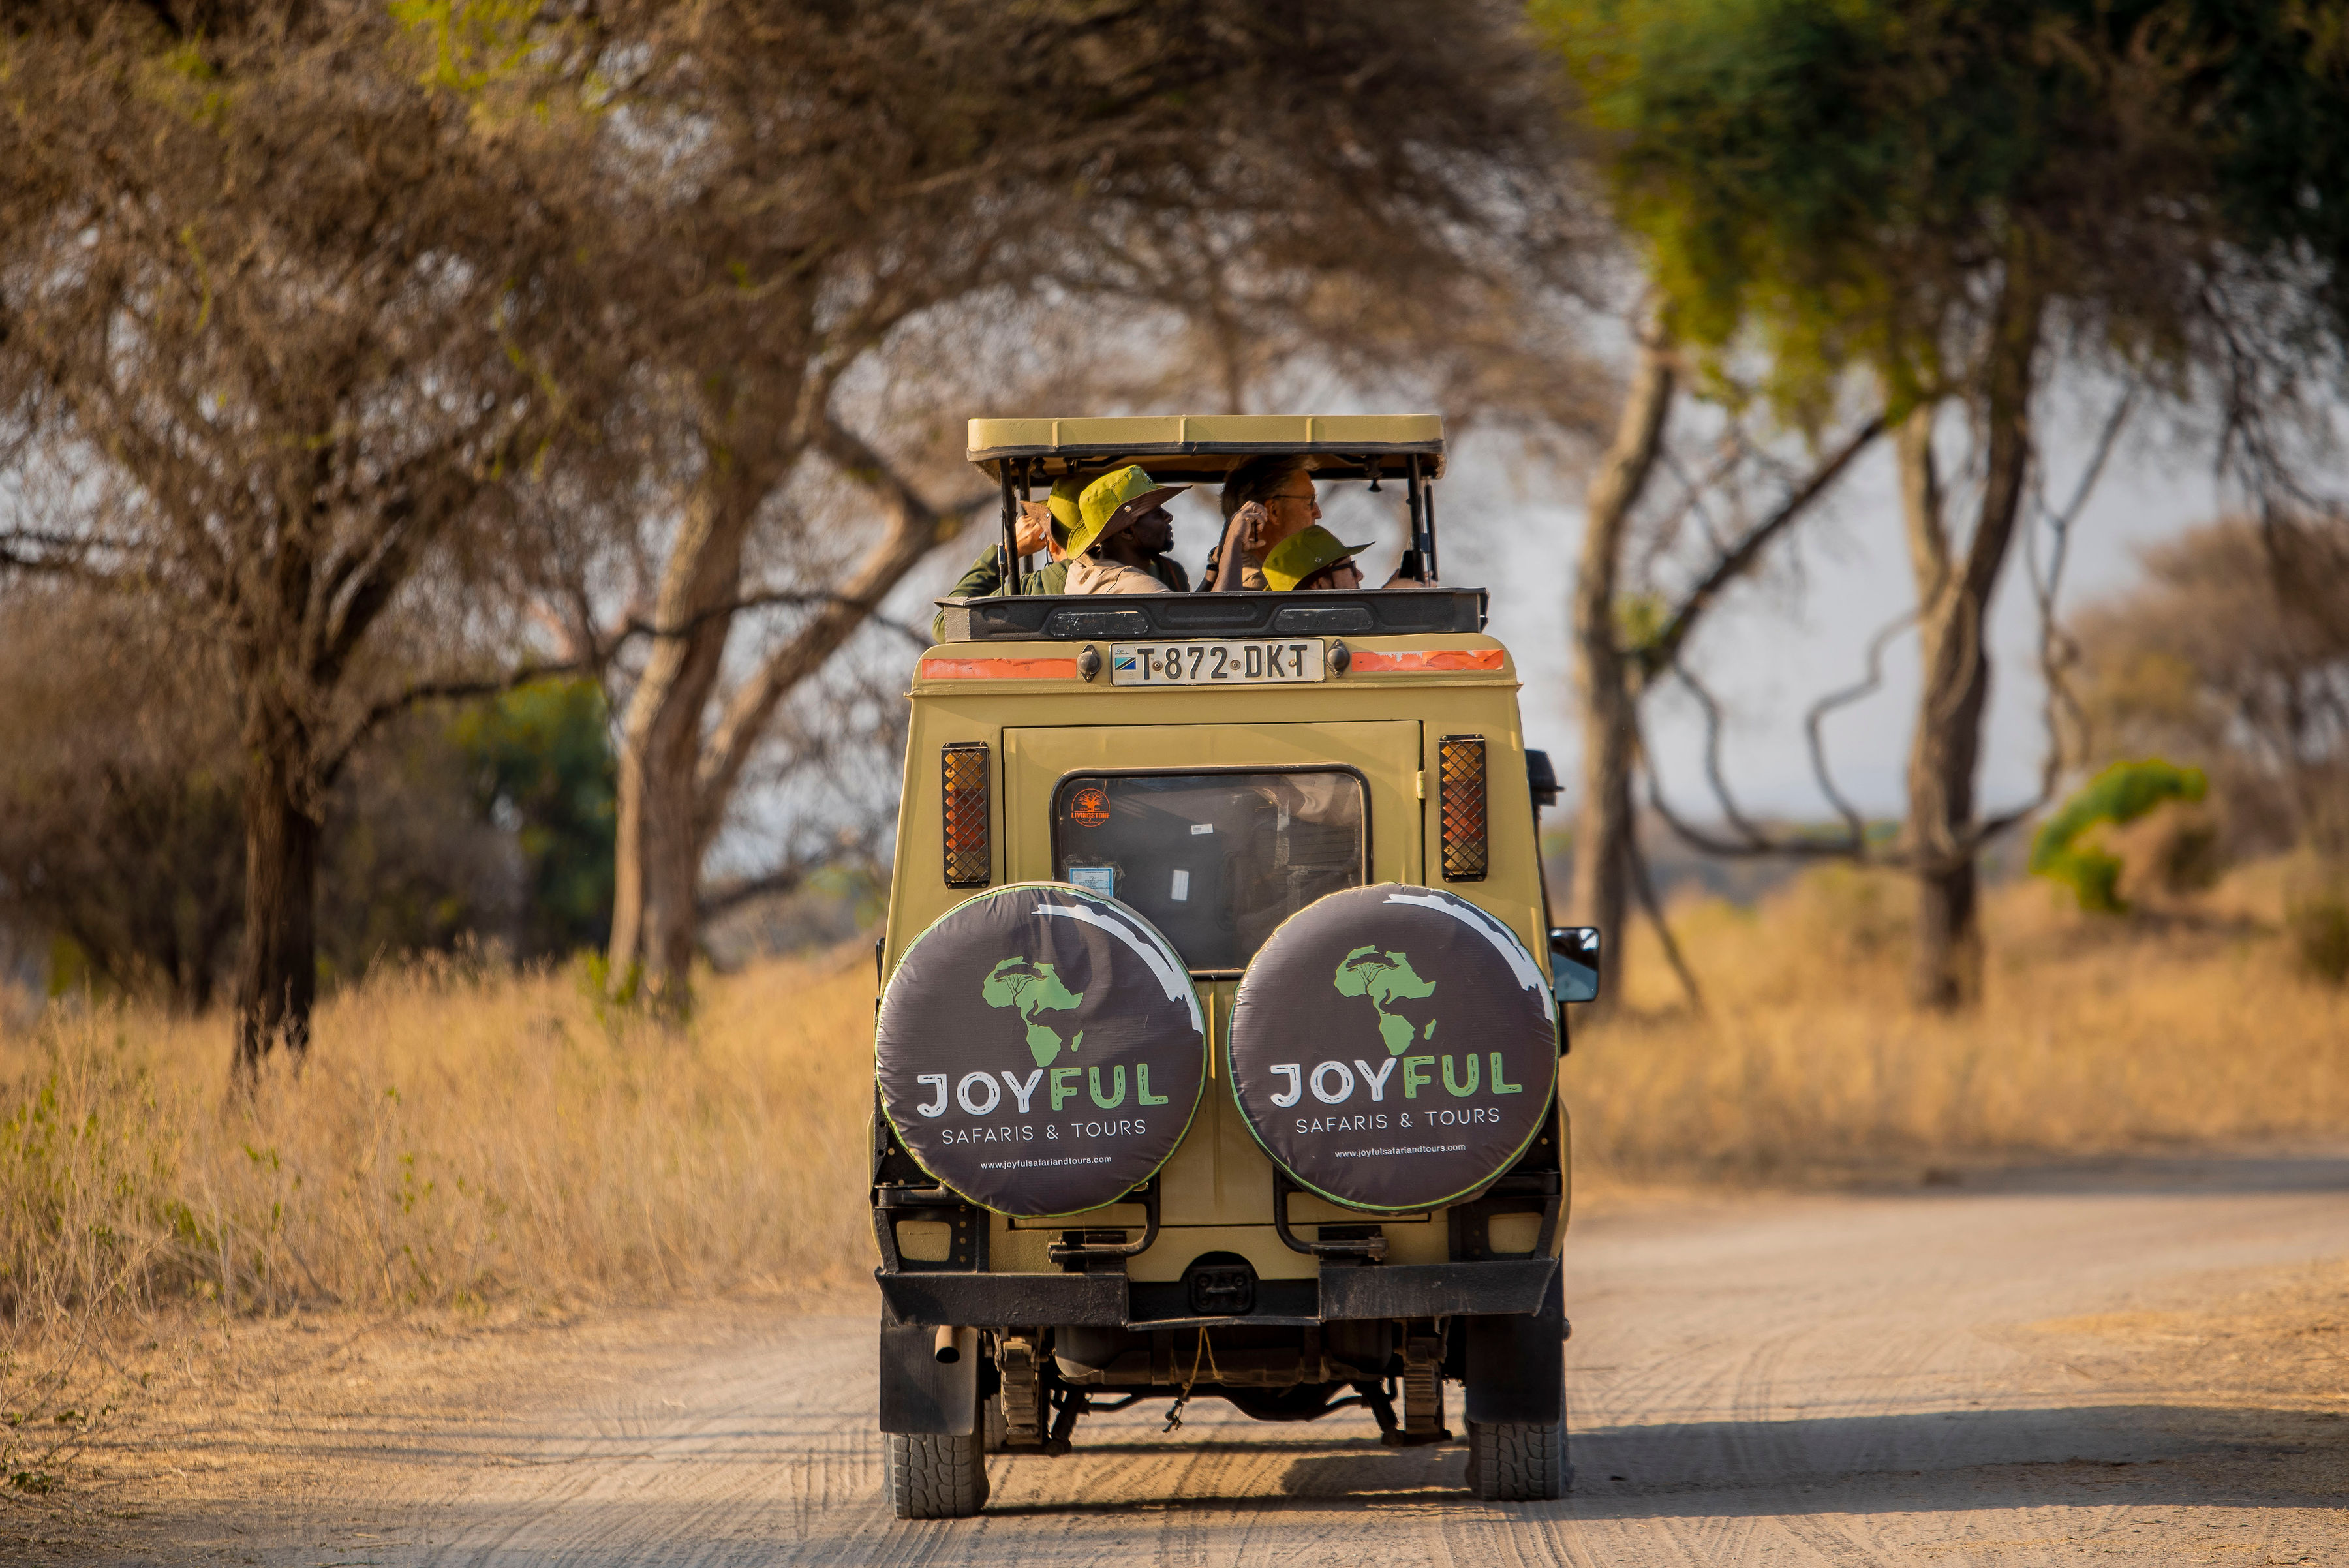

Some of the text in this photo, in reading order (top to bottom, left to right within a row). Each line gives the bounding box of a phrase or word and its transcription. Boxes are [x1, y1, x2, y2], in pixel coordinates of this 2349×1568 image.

[1137, 644, 1308, 680] T 872 DKT
[917, 1063, 1169, 1118] JOYFUL
[1270, 1052, 1523, 1107] JOYFUL
[942, 1120, 1146, 1145] SAFARIS & TOURS
[1296, 1108, 1500, 1134] SAFARIS & TOURS
[981, 1156, 1112, 1169] www.joyfulsafariandtours.com
[1335, 1145, 1466, 1158] www.joyfulsafariandtours.com
